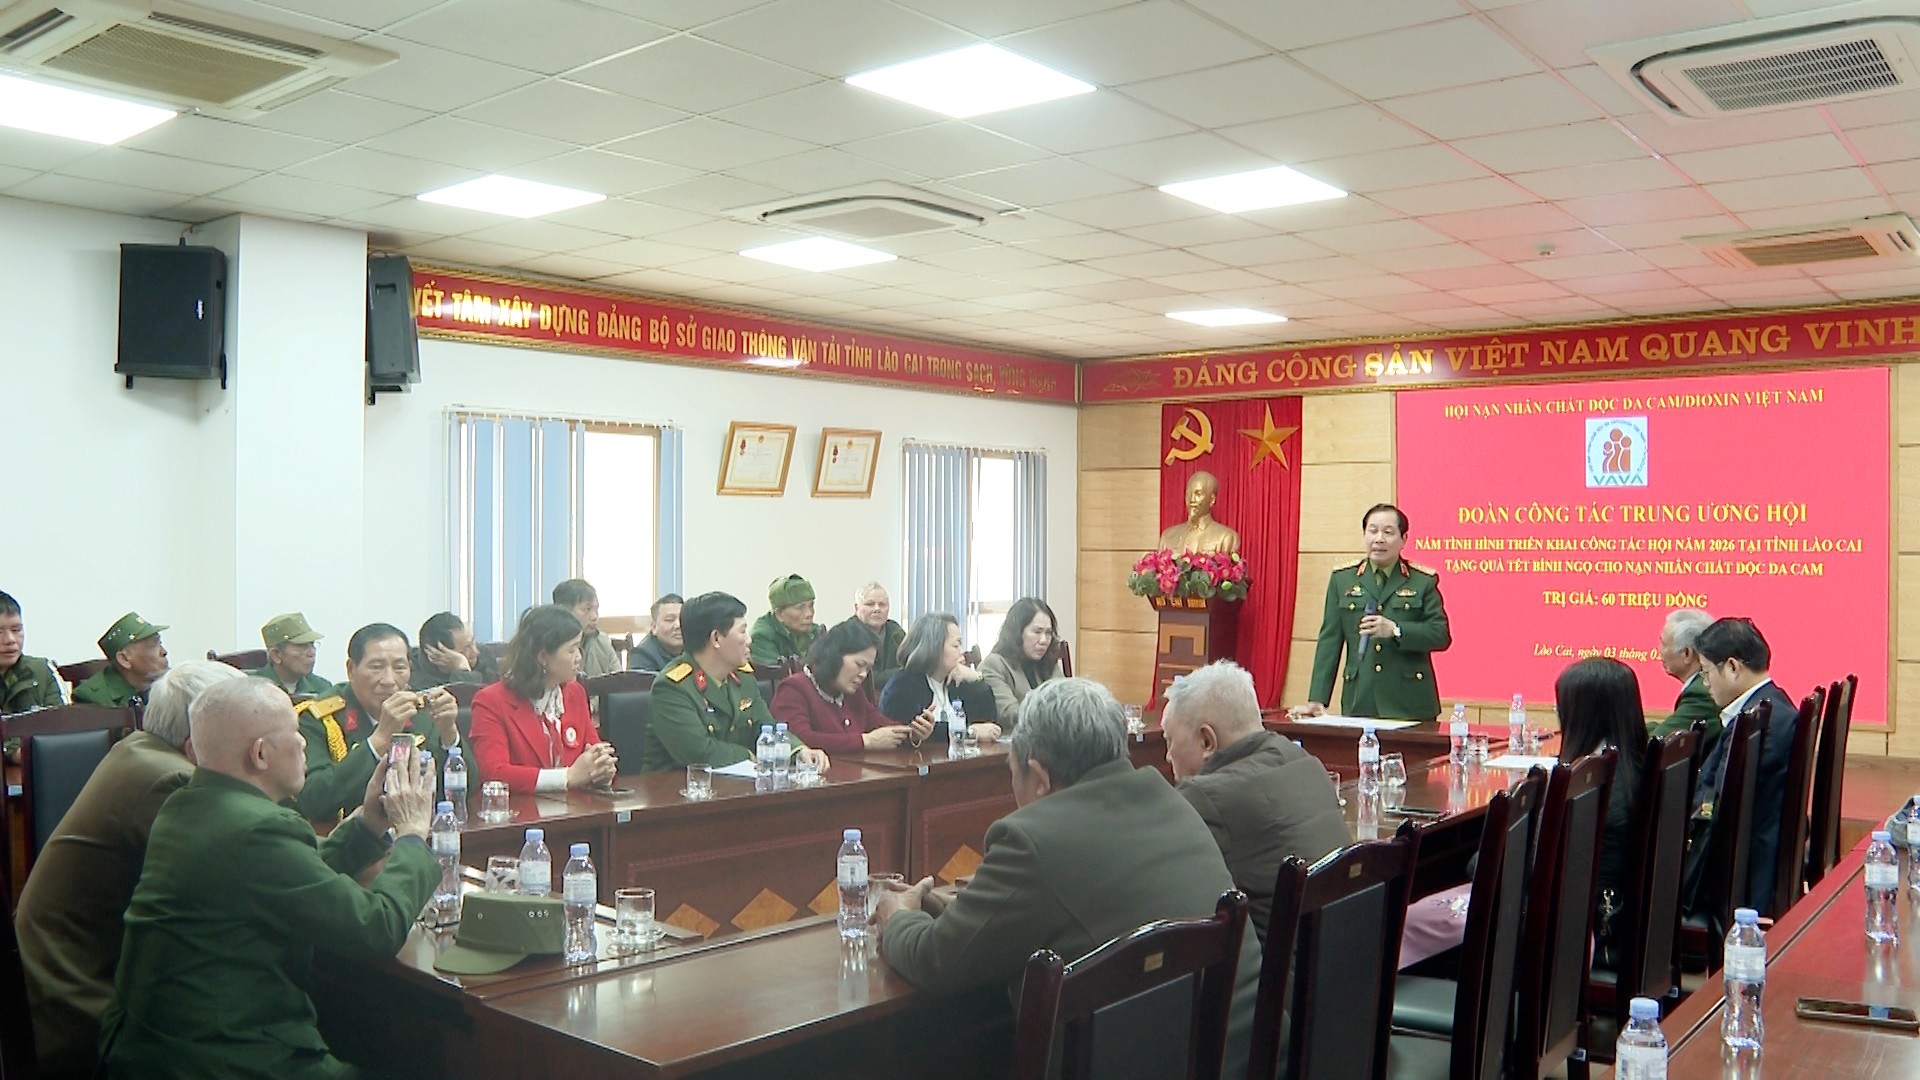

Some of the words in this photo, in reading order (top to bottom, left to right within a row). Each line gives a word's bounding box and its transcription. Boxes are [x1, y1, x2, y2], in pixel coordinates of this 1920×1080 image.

[451, 288, 492, 325] TÂM
[498, 294, 533, 329] XÂY
[539, 303, 589, 338] DỰNG
[597, 303, 642, 342] ĐẢNG
[649, 315, 670, 349] BỘ
[676, 314, 697, 349] SỞ
[701, 325, 736, 353] GIAO
[741, 327, 787, 360] THÔNG
[791, 333, 817, 364] VẬN
[821, 335, 841, 366] TẢI
[844, 337, 873, 369] TỈNH
[877, 345, 899, 372] LÀO
[904, 352, 923, 375] CAI
[927, 356, 962, 382] TRONG
[1172, 357, 1258, 388] ĐẢNG
[1266, 351, 1357, 387] CỘNG
[1364, 343, 1434, 377] SẢN
[1445, 339, 1529, 375] VIỆT
[1539, 335, 1630, 366] NAM
[1639, 324, 1791, 362] QUANG
[1804, 316, 1920, 350] VINH
[1444, 403, 1469, 420] HỘI
[1473, 403, 1500, 420] NẠN
[1504, 398, 1542, 415] NHÂN
[1623, 396, 1643, 410] DA
[1646, 392, 1740, 410] CAM/DIOXIN
[1744, 389, 1782, 408] VIỆT
[1786, 388, 1824, 404] NAM
[1593, 474, 1644, 486] VAVA
[1457, 502, 1509, 524] ĐOÀN
[1514, 501, 1569, 524] CÔNG
[1574, 501, 1615, 524] TÁC
[1619, 502, 1690, 524] TRUNG
[1697, 501, 1760, 523] ƯƠNG
[1767, 501, 1807, 527] HỘI
[1443, 535, 1472, 550] TÌNH
[1474, 535, 1504, 550] HÌNH
[1546, 539, 1577, 550] KHAI
[1580, 535, 1616, 550] CÔNG
[1619, 535, 1645, 550] TÁC
[1648, 537, 1672, 554] HỘI
[1675, 536, 1705, 551] NĂM
[1709, 539, 1735, 552] 2026
[1738, 539, 1761, 554] TẠI
[1802, 535, 1832, 552] LÀO
[1835, 539, 1862, 552] CAI
[1479, 558, 1504, 574] QUÀ
[1565, 561, 1592, 575] NGỌ
[1595, 561, 1622, 573] CHO
[1625, 561, 1652, 576] NẠN
[1655, 558, 1692, 574] NHÂN
[1769, 562, 1787, 575] DA
[1790, 562, 1824, 576] CAM
[1542, 591, 1566, 608] TRỊ
[1569, 589, 1599, 606] GIÁ:
[1601, 592, 1616, 606] 60
[1618, 591, 1662, 609] TRIỆU
[1534, 643, 1552, 656] Lào
[1555, 643, 1574, 658] Cai,
[1604, 646, 1617, 658] 03
[1619, 646, 1648, 662] tháng
